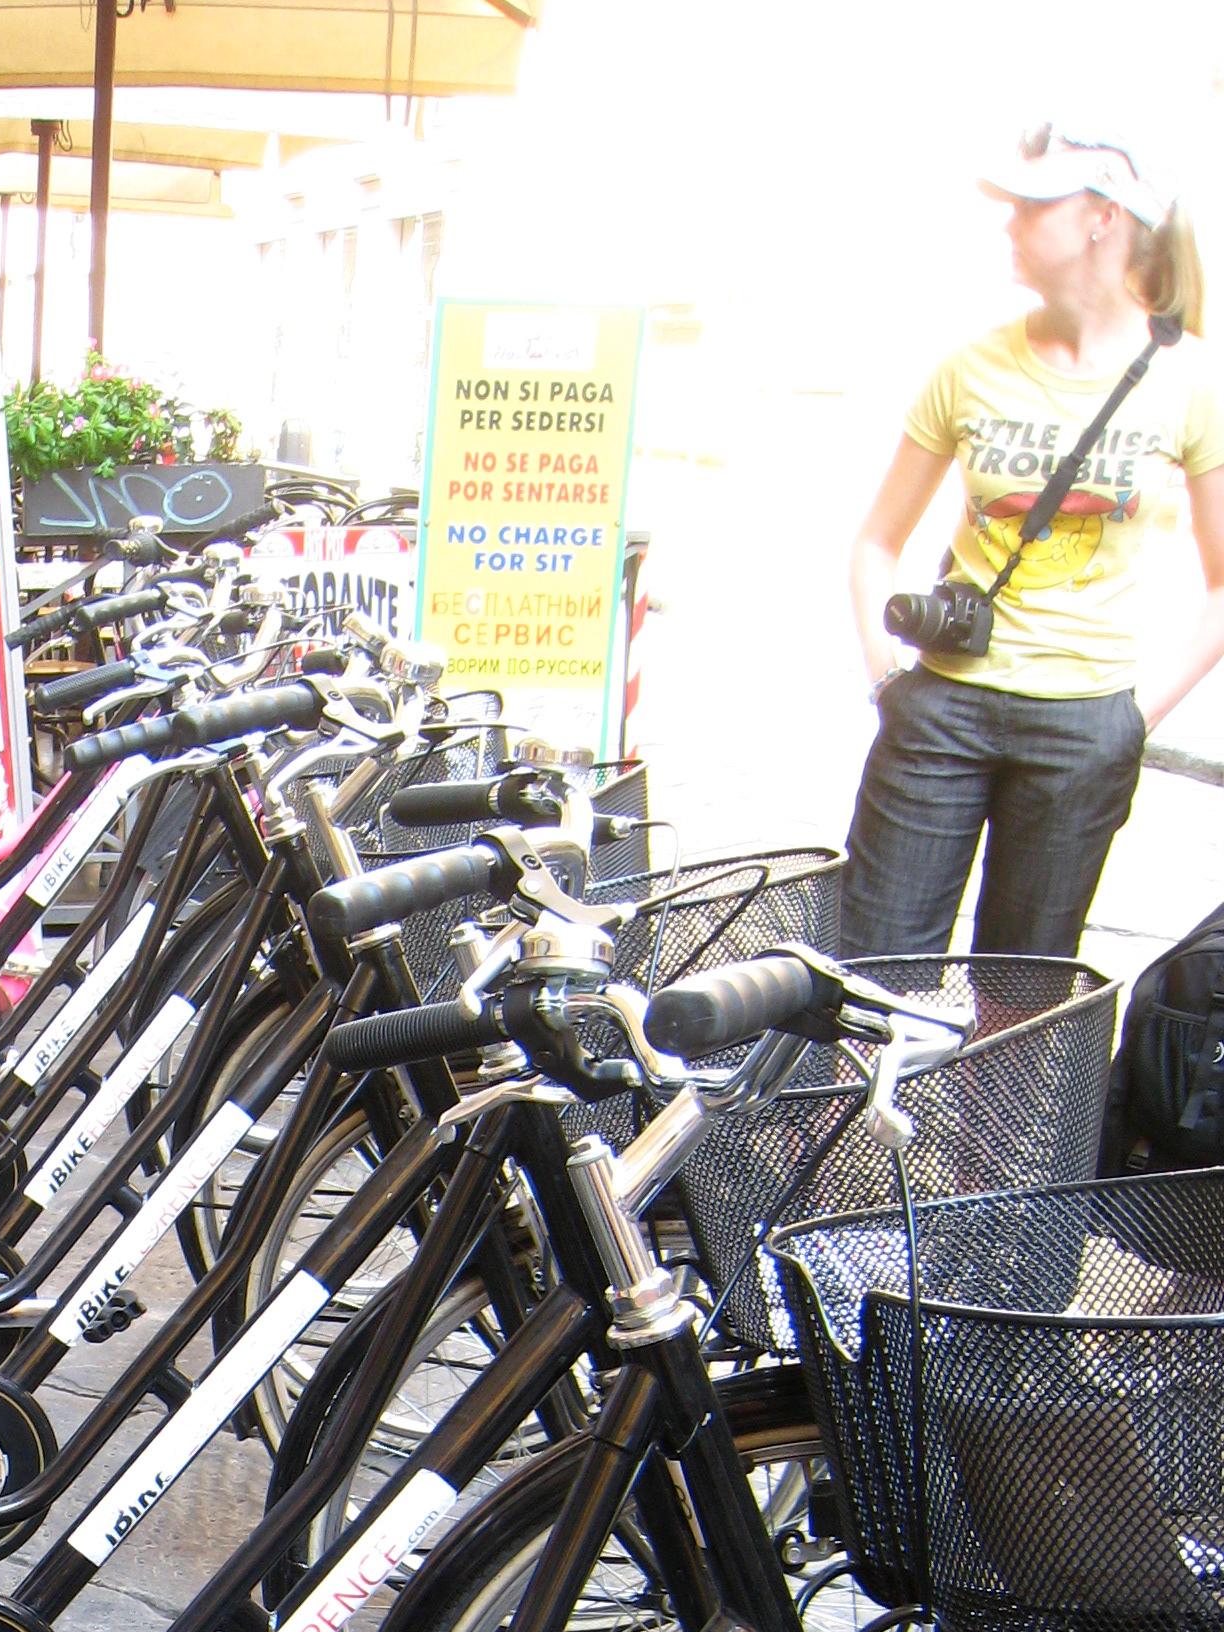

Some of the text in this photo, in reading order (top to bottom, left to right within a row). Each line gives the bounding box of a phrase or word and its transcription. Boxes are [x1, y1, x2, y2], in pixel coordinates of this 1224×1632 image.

[455, 378, 614, 404] NON SI PAGA
[459, 408, 605, 434] PER SEDERSI
[971, 417, 1061, 450] ITTLE
[463, 451, 599, 475] NO SE PAGA
[448, 480, 611, 504] POR SENTARSE
[447, 525, 604, 547] NO CHARGE
[474, 553, 574, 572] FOR SIT
[279, 571, 399, 639] TORANTE
[454, 623, 574, 647] СЕРВИС
[446, 658, 500, 675] ВОРИМ
